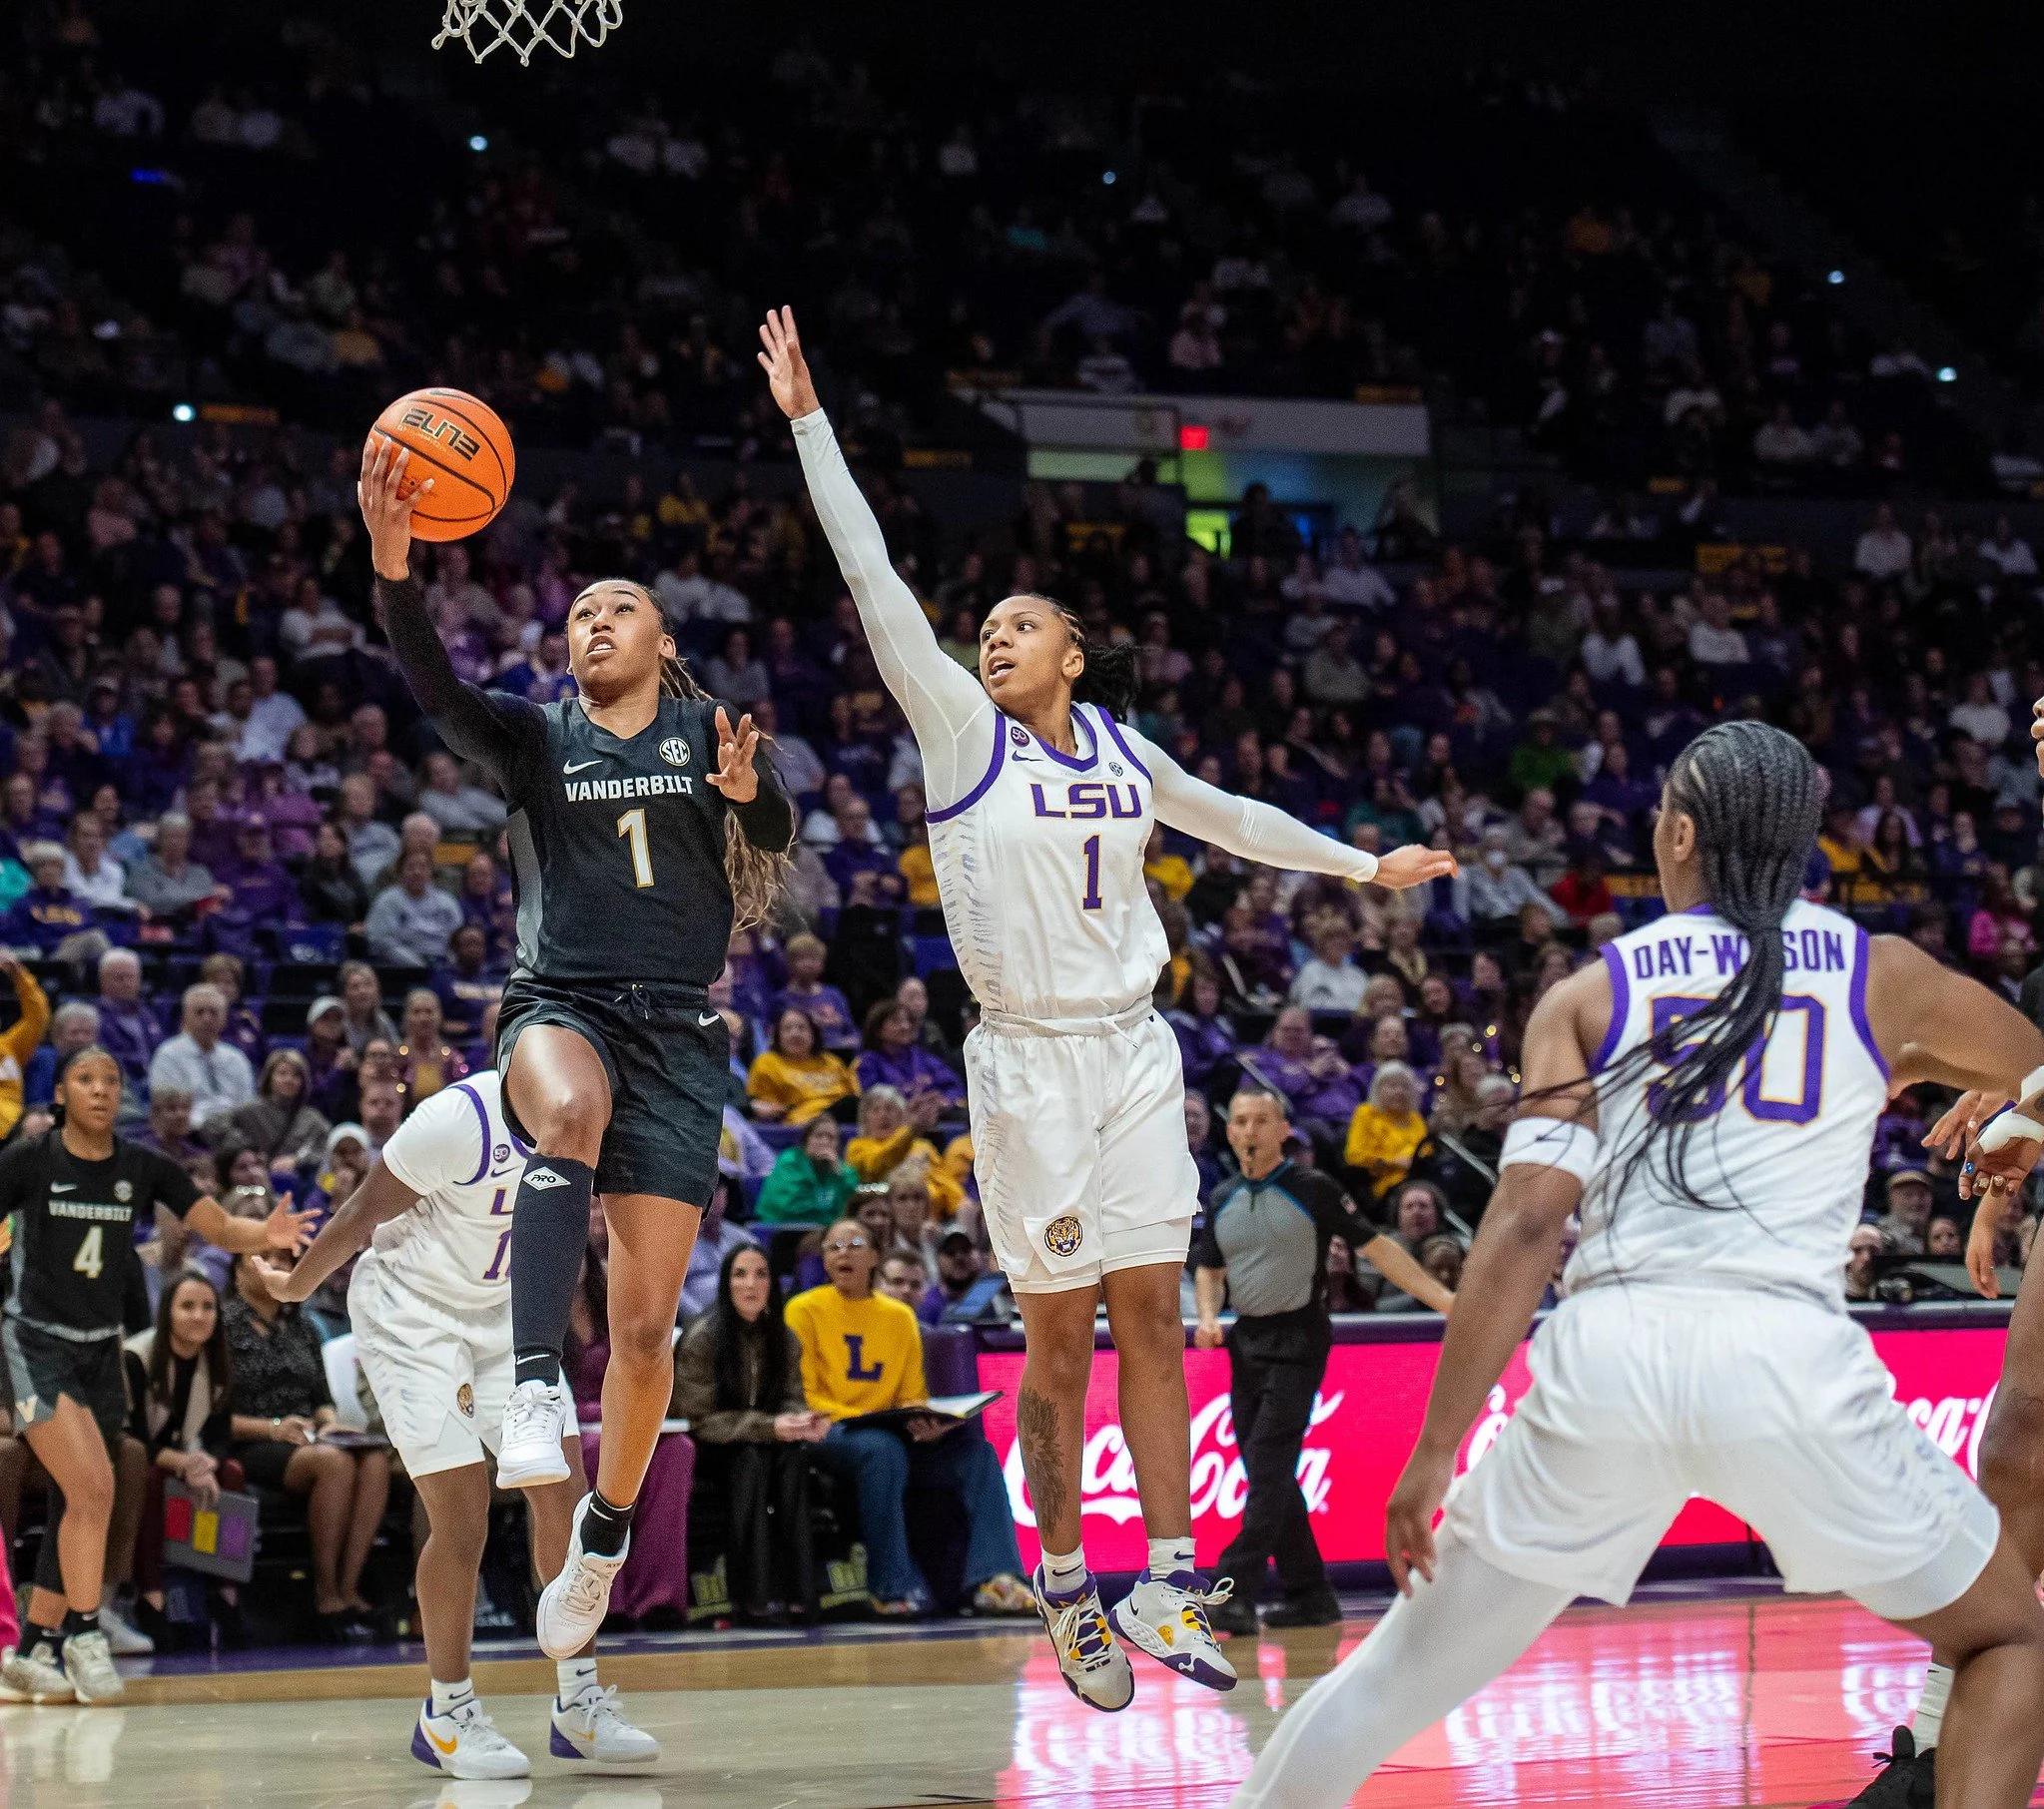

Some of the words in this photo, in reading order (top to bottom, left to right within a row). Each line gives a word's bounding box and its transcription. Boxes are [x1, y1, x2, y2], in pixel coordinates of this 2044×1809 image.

[401, 408, 480, 461] ELITE
[661, 737, 688, 764] SEC
[564, 775, 693, 803] VANDERBILT
[1029, 782, 1142, 819] LSU
[616, 808, 655, 889] 1
[1081, 834, 1102, 910] 1
[1633, 928, 1845, 980] DAY-WSON
[530, 1174, 557, 1184] PRO
[48, 1200, 133, 1222] VANDERBILT
[73, 1224, 104, 1279] 4
[844, 1334, 884, 1382] L
